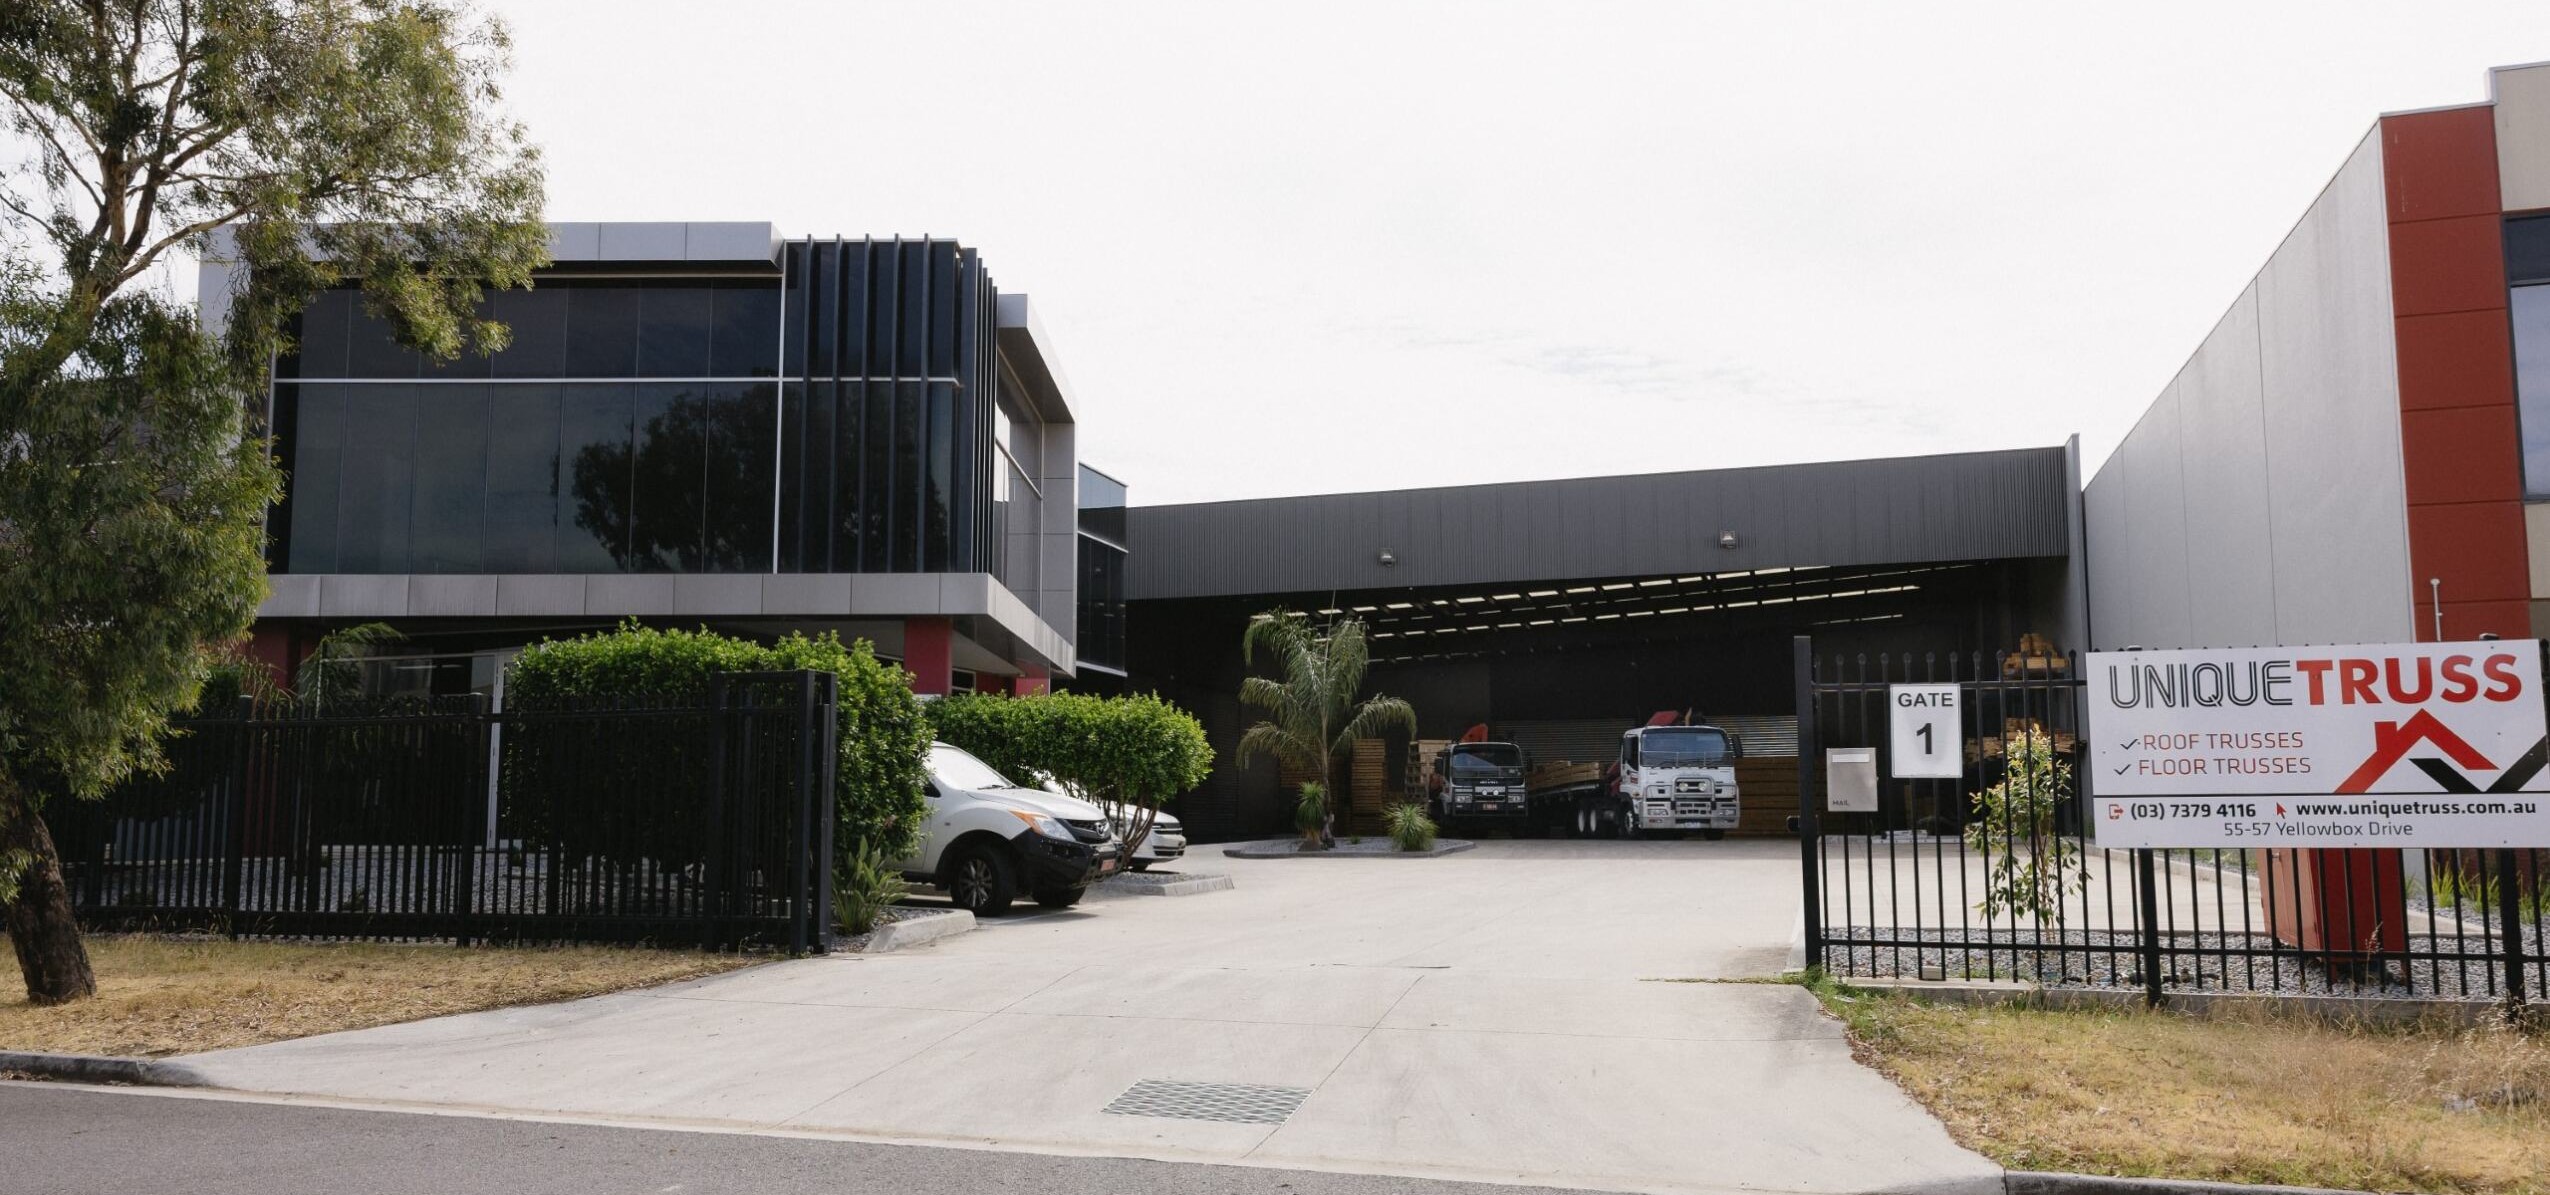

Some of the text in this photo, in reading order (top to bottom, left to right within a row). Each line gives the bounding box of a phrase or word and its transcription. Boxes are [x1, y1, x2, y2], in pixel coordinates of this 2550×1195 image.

[1898, 692, 1953, 707] GATE
[1916, 722, 1933, 755] 1
[2143, 732, 2304, 750] ROOF TRUSSES
[2139, 757, 2312, 775] FLOOR TRUSSES
[2130, 803, 2257, 820] (03) 7379 4116
[2296, 801, 2536, 818] www.uniquetruss.com.au
[2224, 821, 2413, 836] 55-57 Yellowbox Drive
